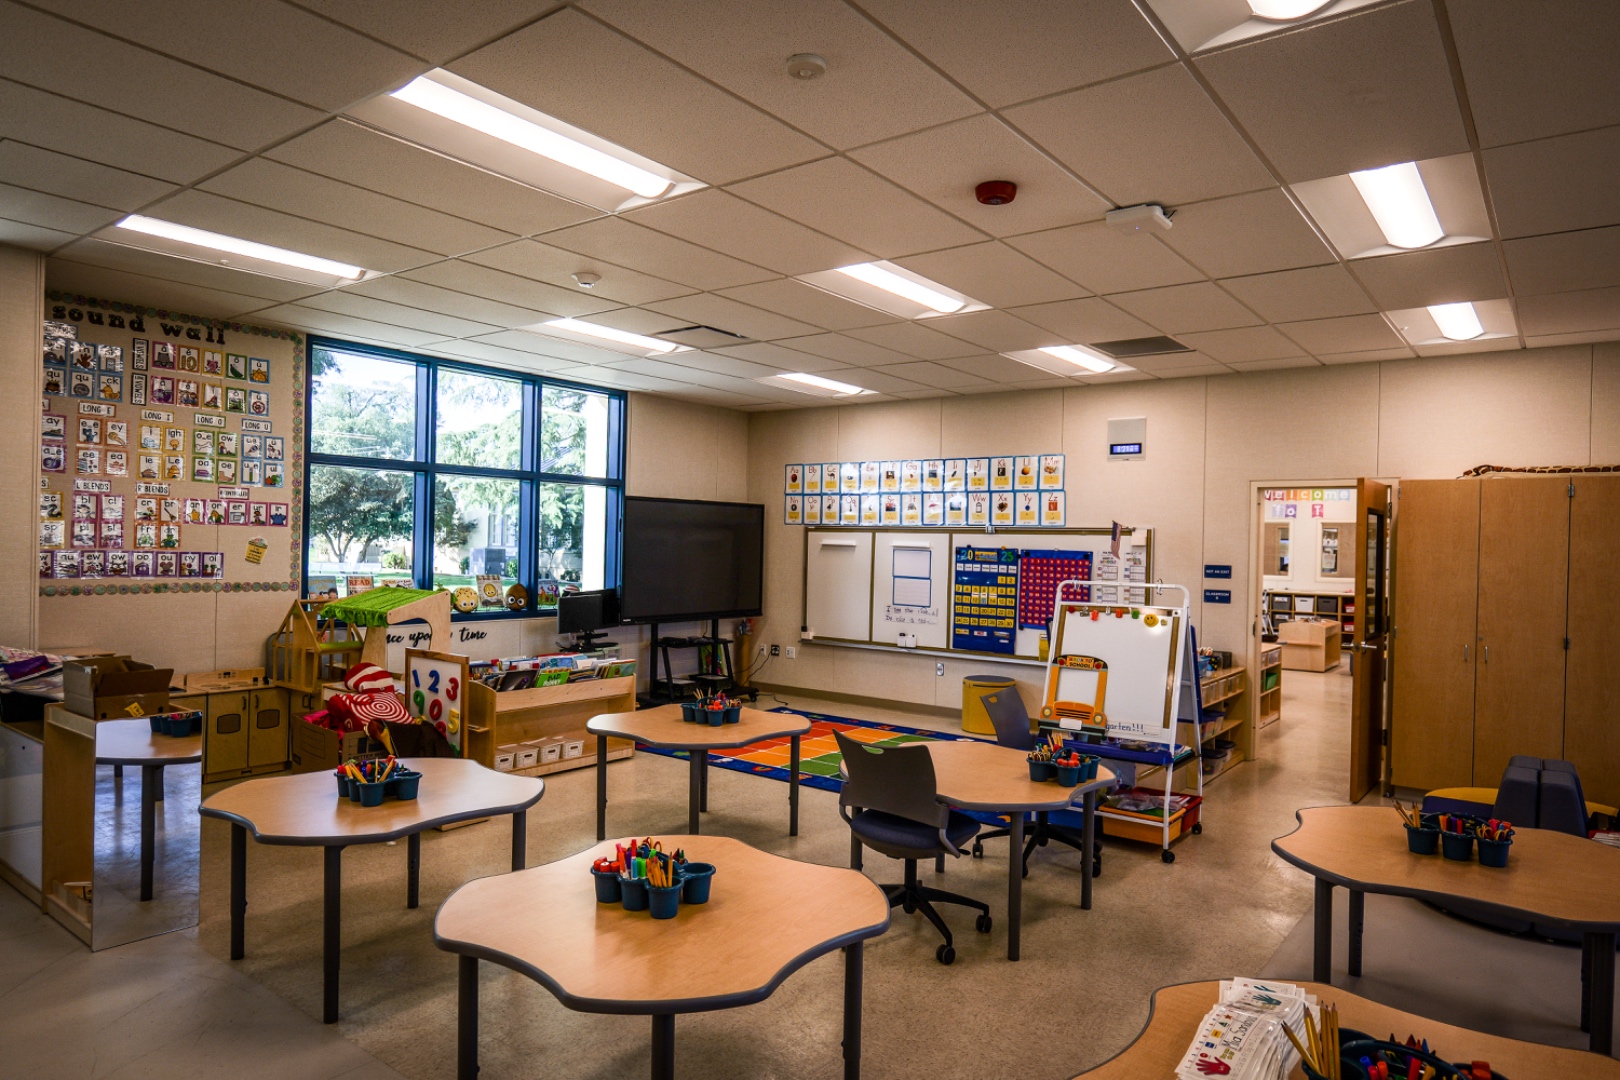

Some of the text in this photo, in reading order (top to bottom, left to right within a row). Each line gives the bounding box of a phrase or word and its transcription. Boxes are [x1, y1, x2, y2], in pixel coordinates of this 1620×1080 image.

[53, 306, 145, 332] sound
[160, 322, 226, 345] wall
[83, 404, 101, 413] LONG
[144, 412, 161, 420] LONG
[46, 418, 60, 426] ay
[144, 485, 168, 493] BLENDS
[1023, 494, 1032, 504] Yy
[1048, 493, 1058, 501] Zz
[44, 525, 57, 533] sp
[1001, 551, 1014, 562] 25
[459, 627, 488, 642] time
[412, 669, 459, 700] 1 2 3
[414, 690, 459, 734] 9 0 5
